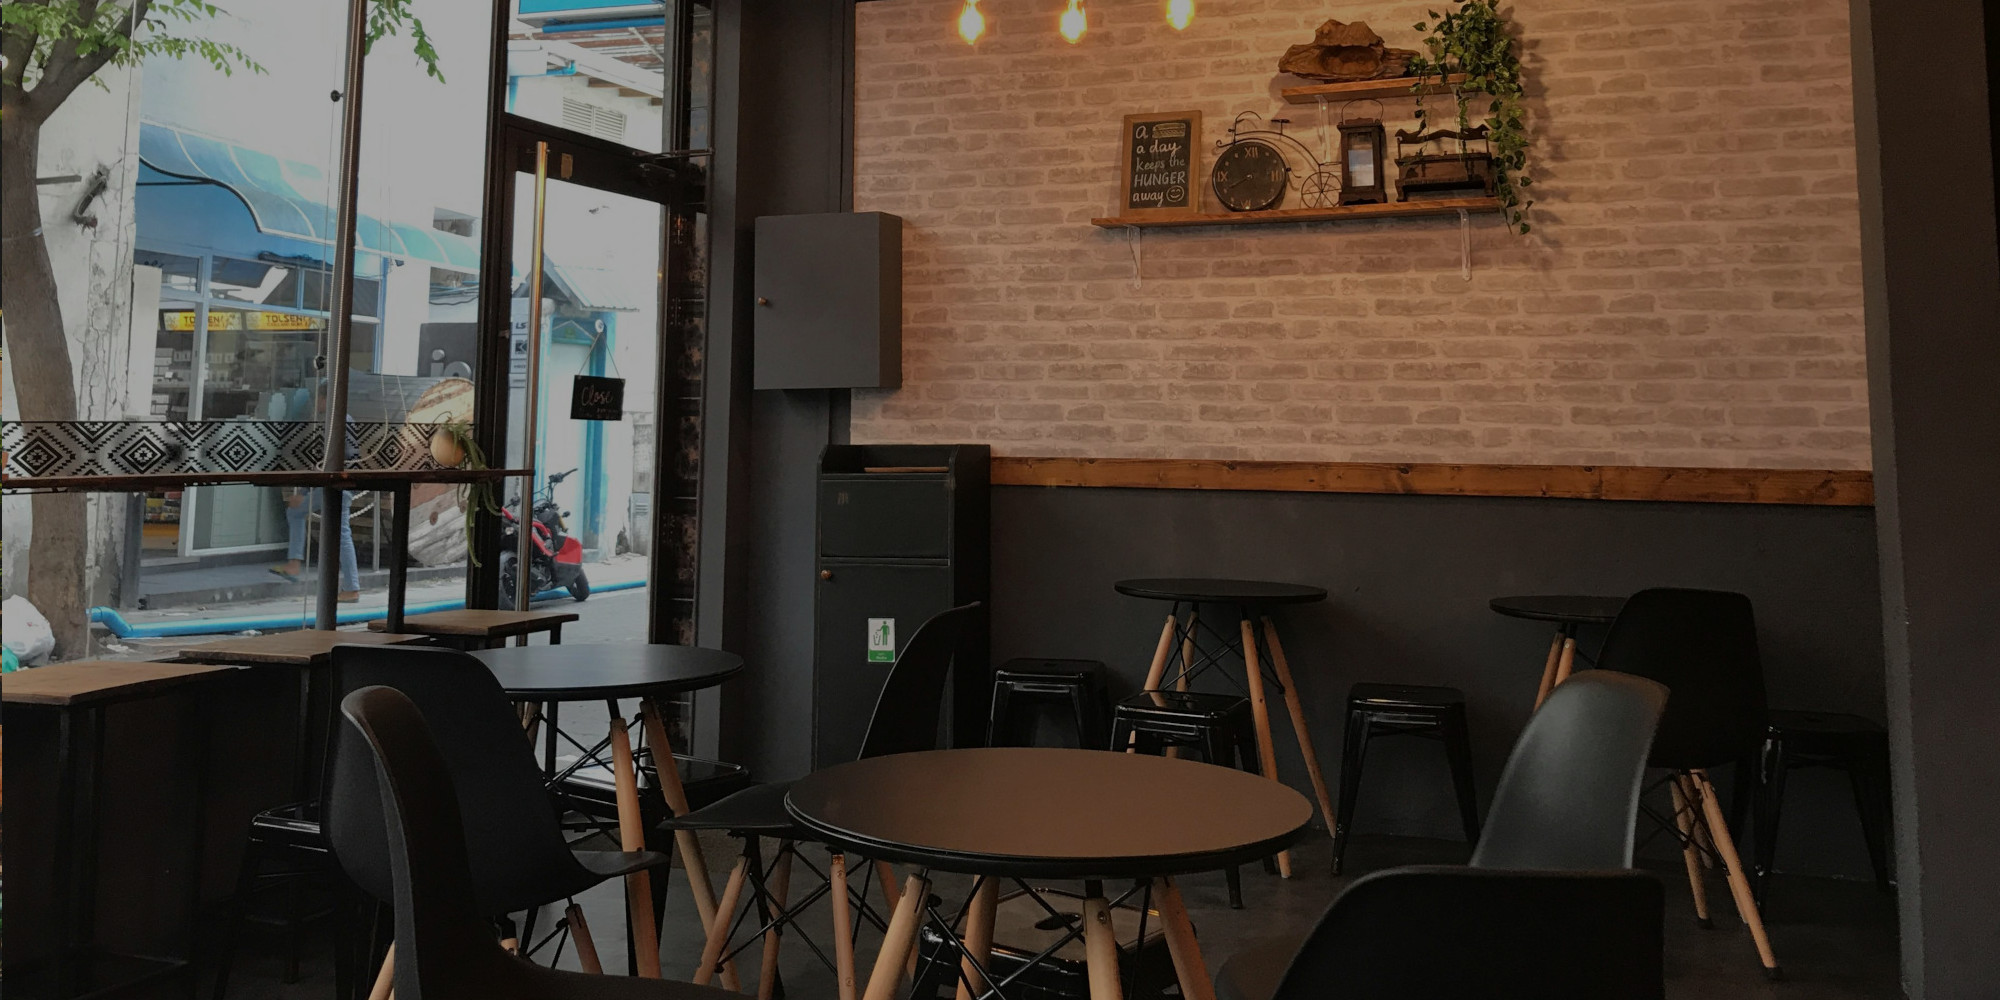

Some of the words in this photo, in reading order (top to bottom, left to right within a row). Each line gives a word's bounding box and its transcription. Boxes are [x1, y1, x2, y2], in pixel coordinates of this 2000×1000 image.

[1149, 139, 1182, 157] day
[1244, 146, 1259, 159] XII
[1135, 156, 1166, 173] keeps
[1169, 155, 1185, 167] the
[1134, 171, 1186, 188] HUNGER
[1217, 170, 1229, 182] IX
[1132, 190, 1164, 208] away
[265, 314, 303, 323] TOLSEN
